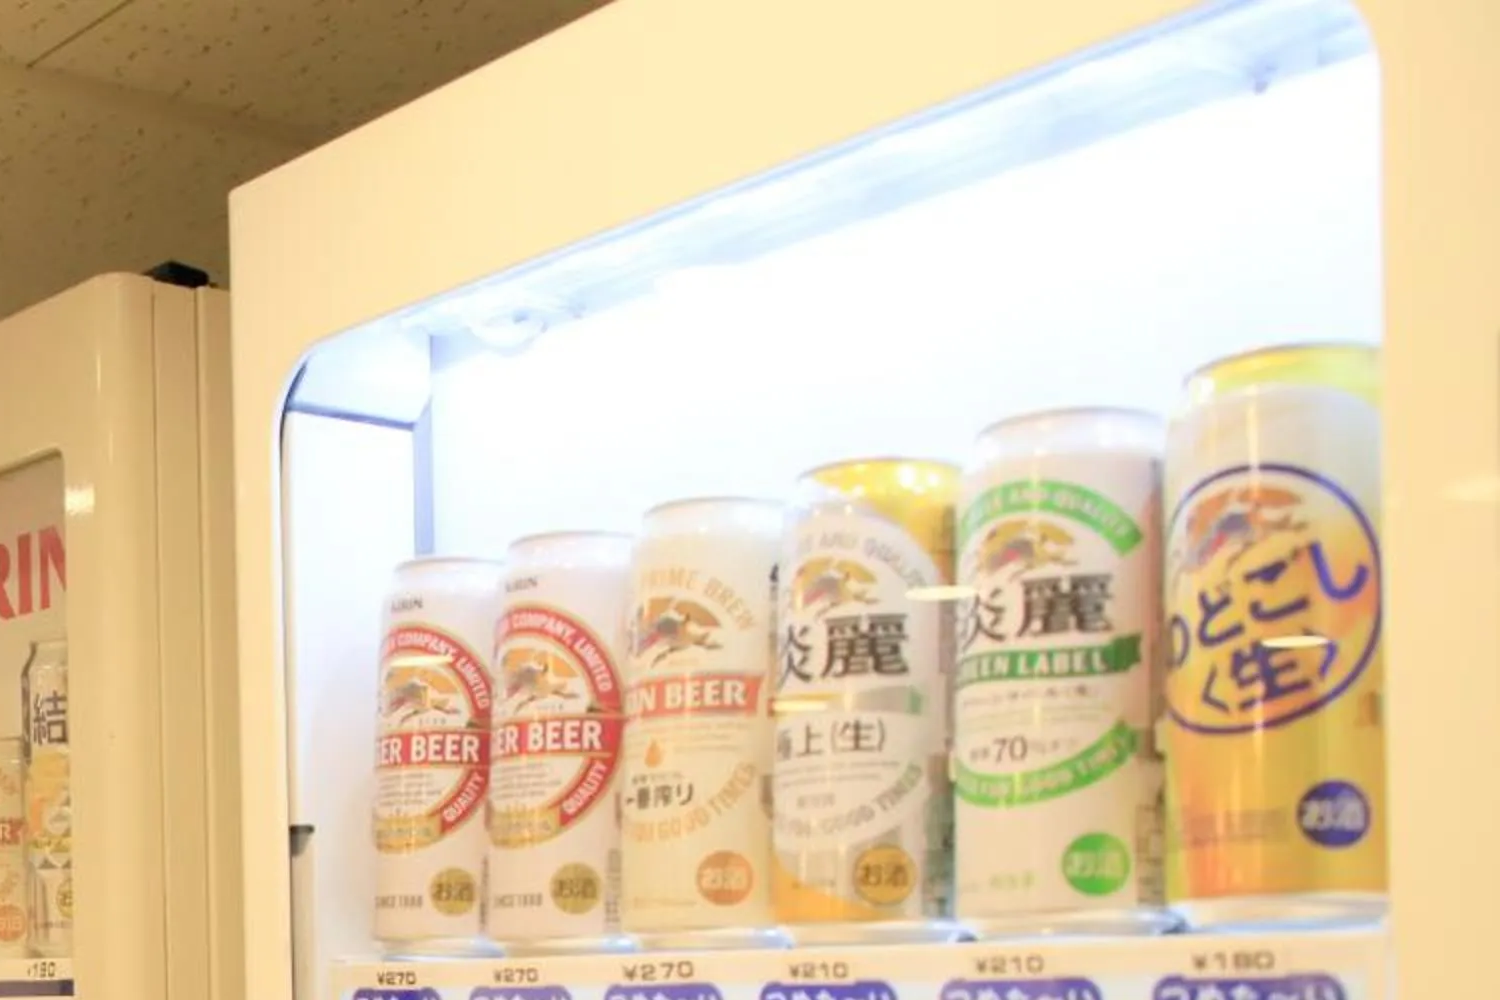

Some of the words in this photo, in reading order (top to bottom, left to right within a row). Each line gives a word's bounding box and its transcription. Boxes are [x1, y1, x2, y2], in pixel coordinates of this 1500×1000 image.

[574, 637, 613, 693] LIMITED
[1019, 650, 1112, 676] LABEL
[665, 679, 746, 710] BEER
[411, 733, 479, 762] BEER
[527, 721, 602, 752] BEER
[443, 771, 484, 822] QUALITY
[562, 760, 607, 815] QUALITY
[1302, 792, 1366, 831] お酒
[861, 863, 908, 888] お酒
[622, 961, 694, 982] ¥270
[788, 961, 849, 980] ¥210
[975, 955, 1045, 976] ¥210
[1191, 951, 1275, 973] ¥180
[377, 971, 417, 986] ¥270
[493, 967, 539, 984] ¥270
